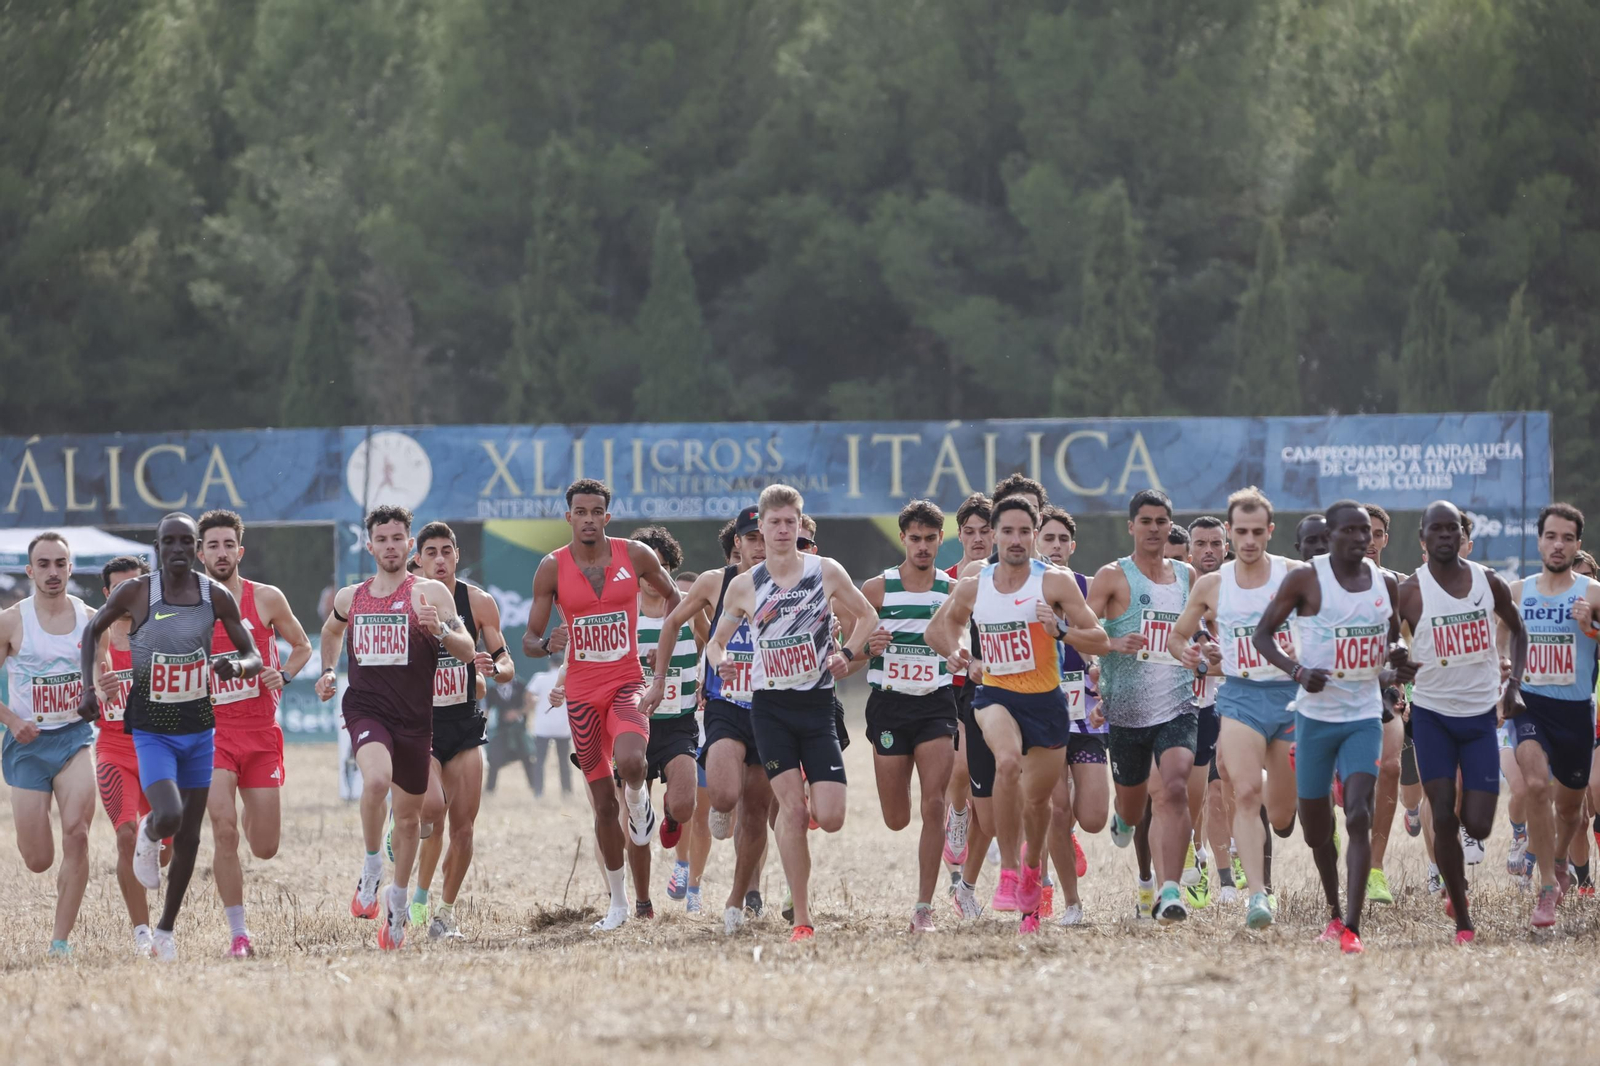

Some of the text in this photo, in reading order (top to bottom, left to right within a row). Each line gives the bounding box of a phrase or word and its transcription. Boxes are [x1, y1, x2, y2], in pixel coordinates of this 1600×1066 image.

[650, 437, 785, 473] CROSS
[1281, 440, 1524, 462] CAMPEONATO DE ANDALUCÍA
[7, 434, 246, 513] ÁLICA
[478, 438, 645, 497] XLIII
[1320, 462, 1343, 477] DE
[1344, 461, 1406, 476] CAMPO
[1408, 460, 1421, 475] A
[1357, 472, 1453, 491] POR CLUBES
[639, 497, 699, 517] CROSS
[767, 588, 811, 602] saucony
[1524, 603, 1574, 624] nerja
[1530, 625, 1571, 633] ATLETISMO
[355, 625, 406, 655] LAS HERAS
[574, 621, 627, 652] BARROS
[980, 629, 1031, 664] FONTES
[760, 642, 817, 679] VANOPPEN
[1335, 635, 1386, 670] KOECH
[152, 659, 205, 694] BETT
[433, 666, 467, 697] OSA V
[888, 662, 934, 682] 5125
[33, 680, 83, 714] MENACHO
